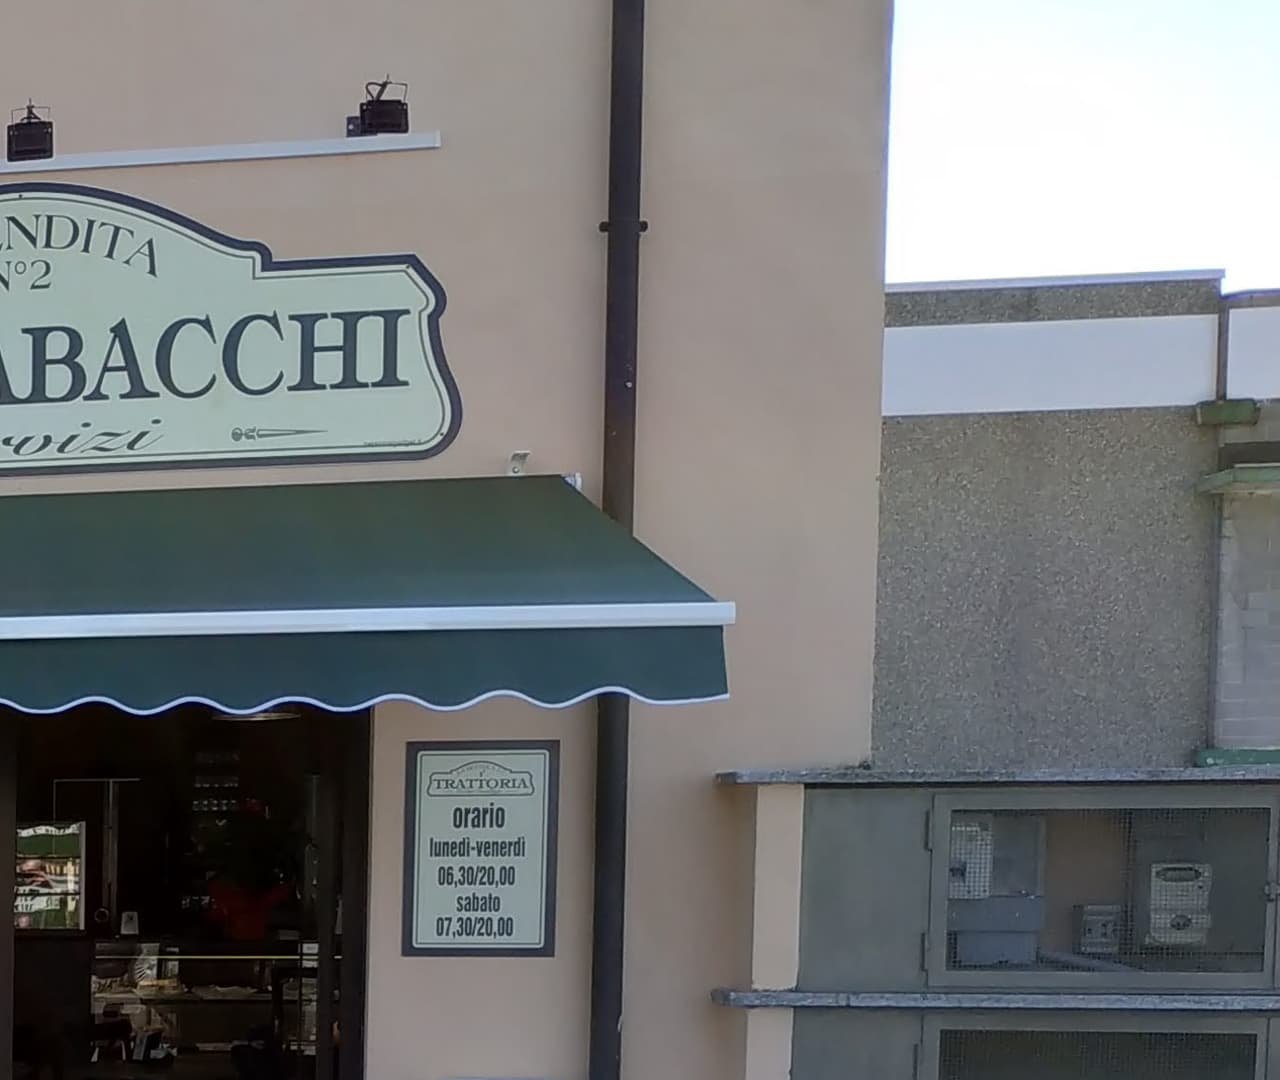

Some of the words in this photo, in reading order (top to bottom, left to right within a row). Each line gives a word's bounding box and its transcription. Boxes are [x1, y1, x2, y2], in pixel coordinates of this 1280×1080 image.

[433, 777, 529, 789] TRATTORIA
[453, 803, 505, 828] orario
[429, 836, 525, 857] lunedì-venerdì
[438, 866, 515, 888] 06,30/20,00
[456, 892, 500, 912] sabato
[436, 917, 513, 938] 07,30/20,00
